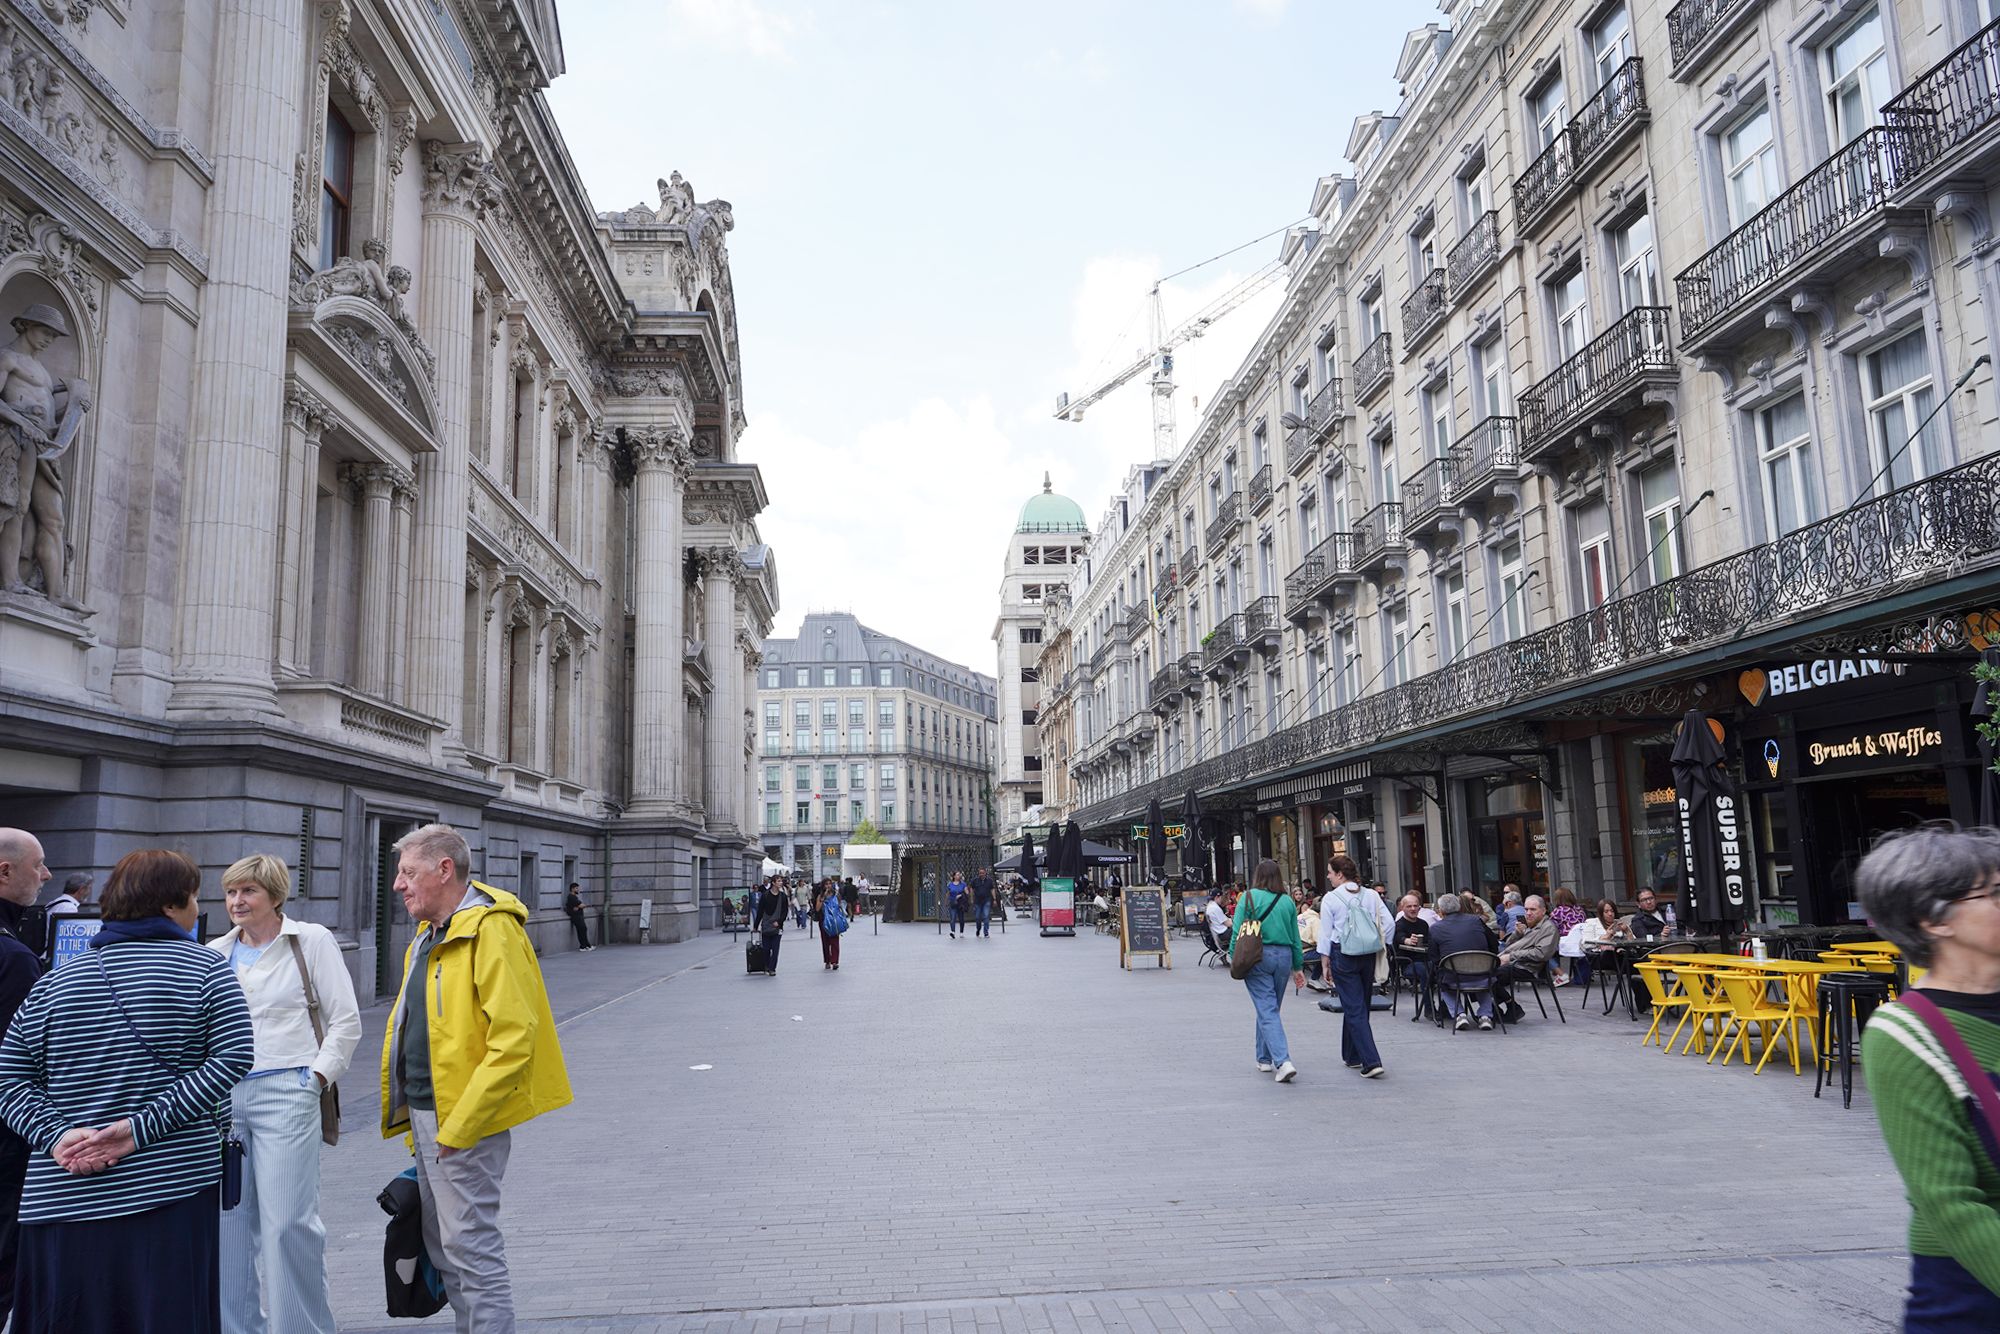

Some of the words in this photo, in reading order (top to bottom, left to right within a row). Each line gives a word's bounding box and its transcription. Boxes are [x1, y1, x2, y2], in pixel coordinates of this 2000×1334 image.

[1768, 646, 1881, 696] BELGIAN
[1809, 736, 1861, 765] Brunch
[1865, 735, 1879, 756] &
[1879, 727, 1942, 757] Waffles
[1715, 795, 1741, 871] SUPER
[56, 939, 67, 951] AT
[69, 939, 82, 951] THE
